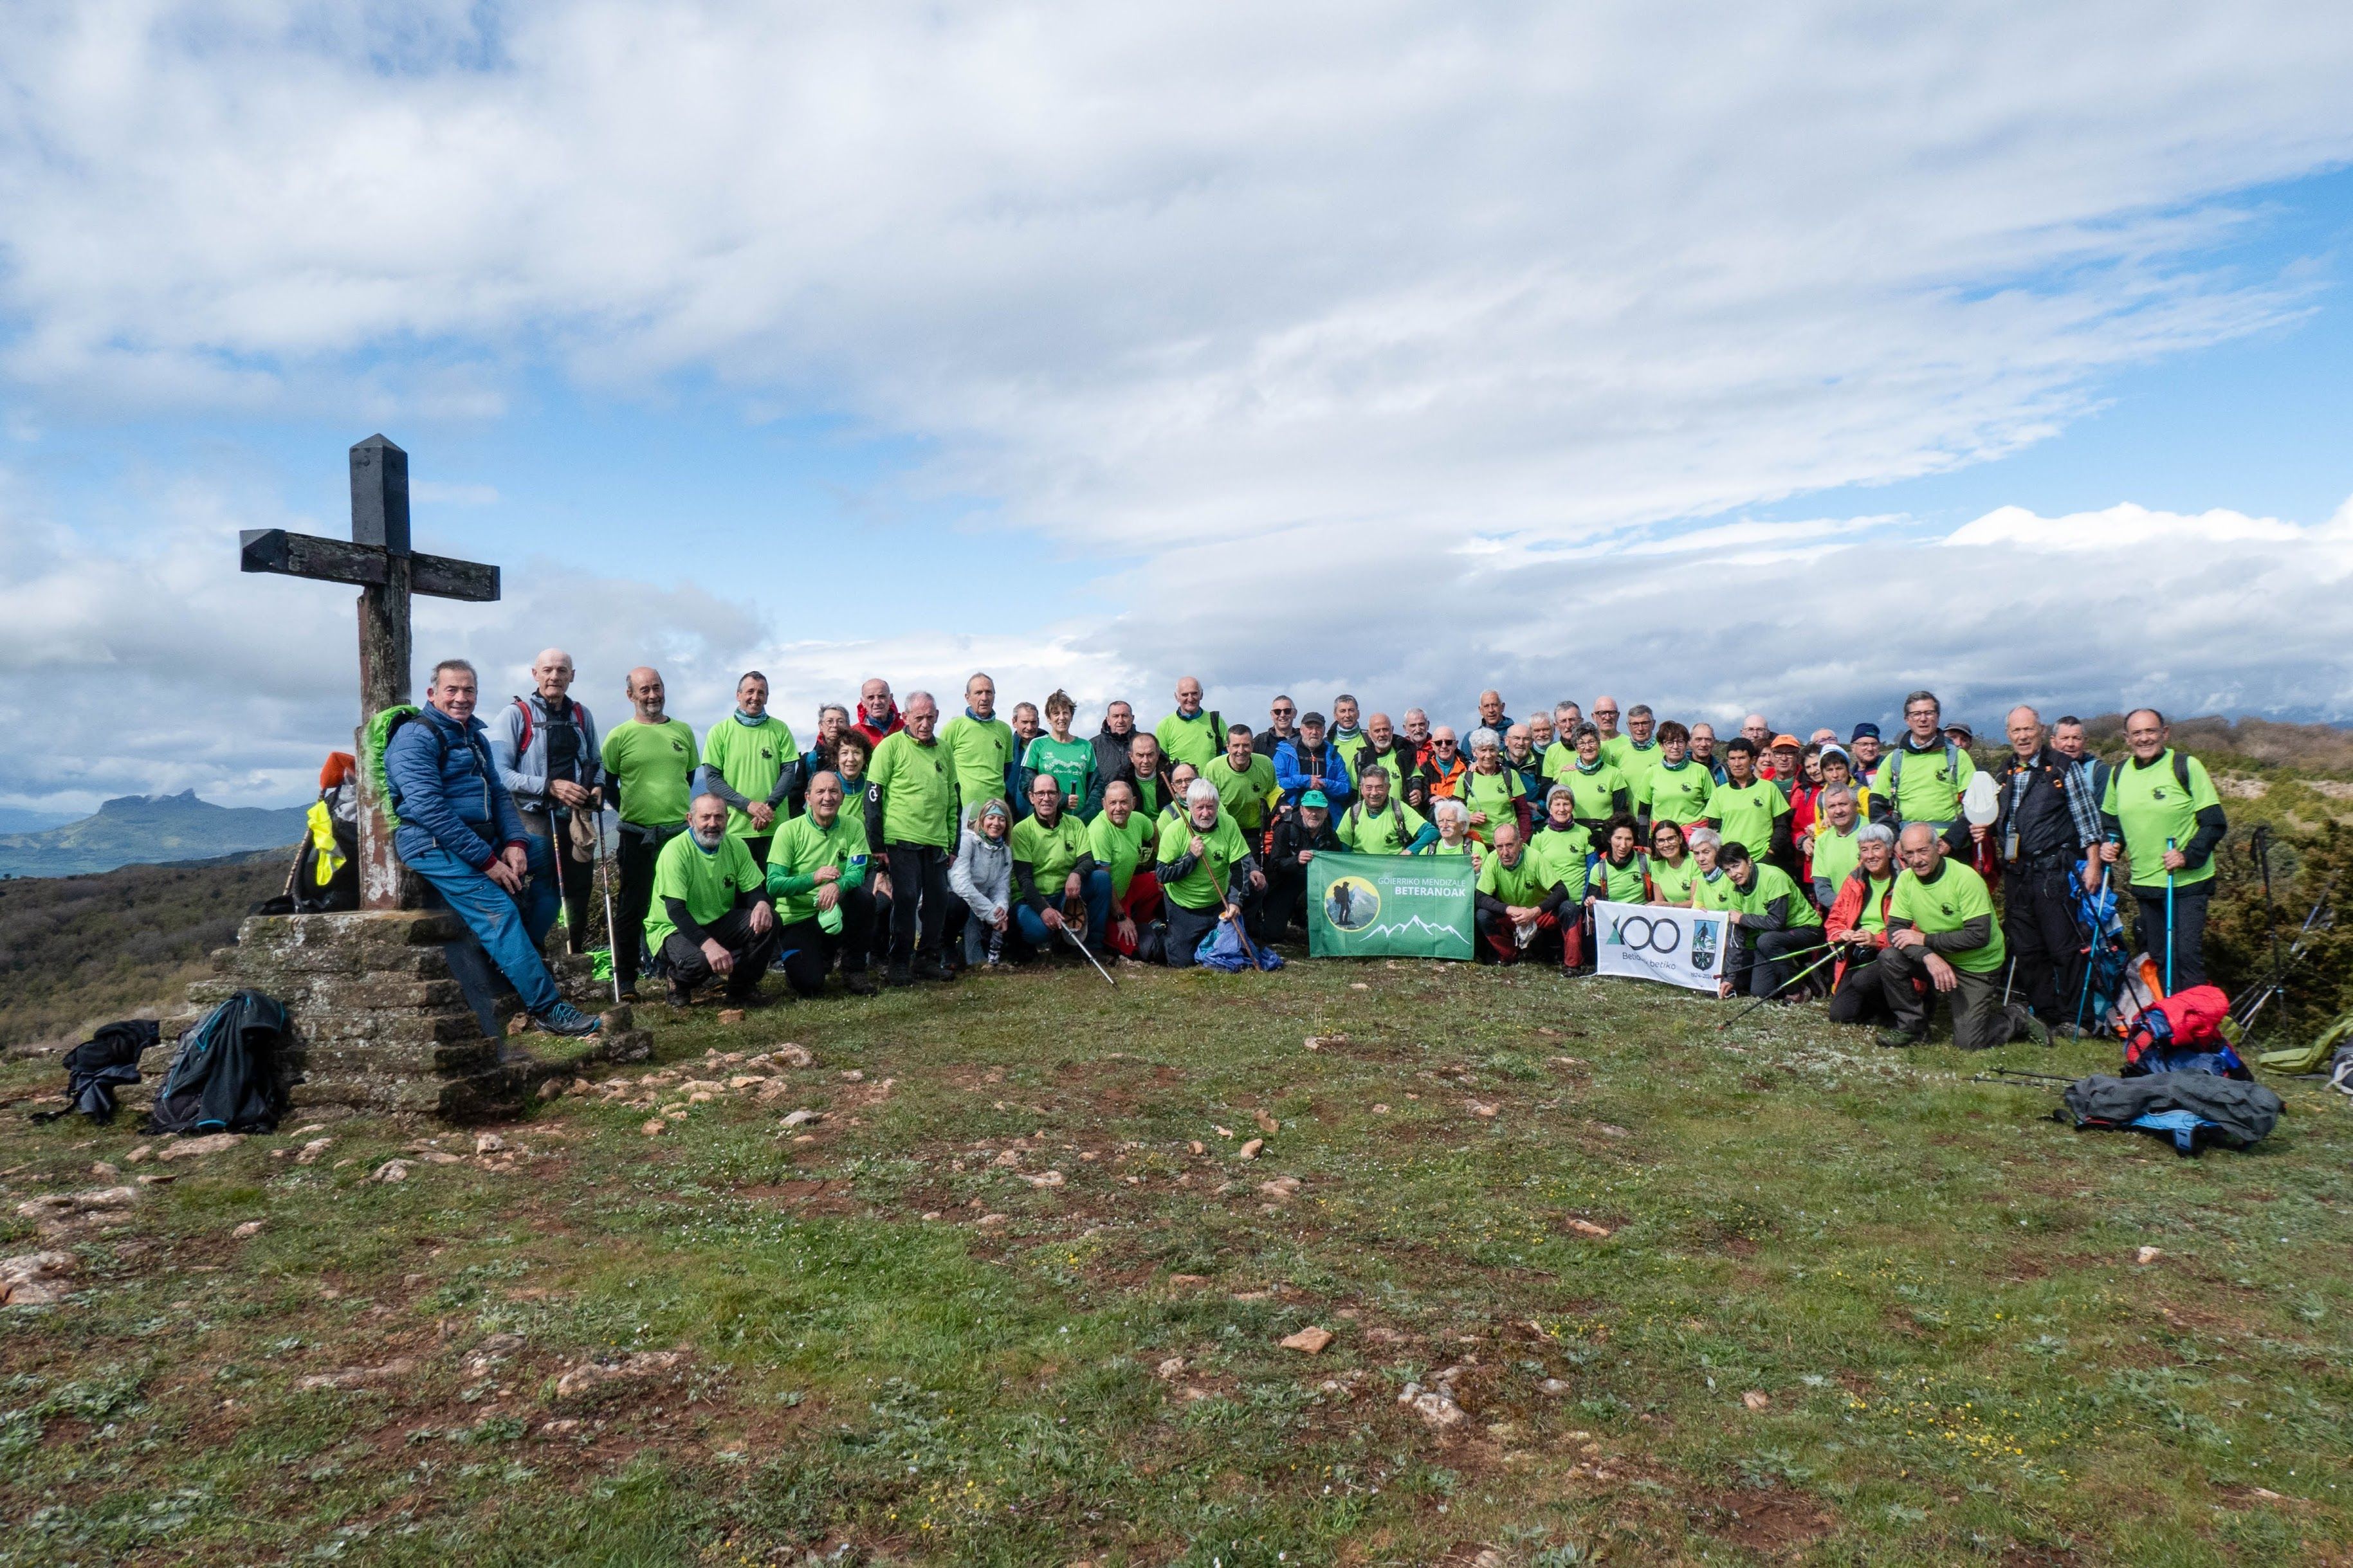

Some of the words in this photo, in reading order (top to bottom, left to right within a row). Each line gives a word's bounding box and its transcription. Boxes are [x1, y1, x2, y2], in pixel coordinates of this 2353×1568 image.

[1378, 877, 1420, 886] GOIERRIKO
[1422, 879, 1466, 887] MENDIZALE
[1395, 886, 1466, 897] BETERANOAK
[1650, 959, 1676, 970] betiko
